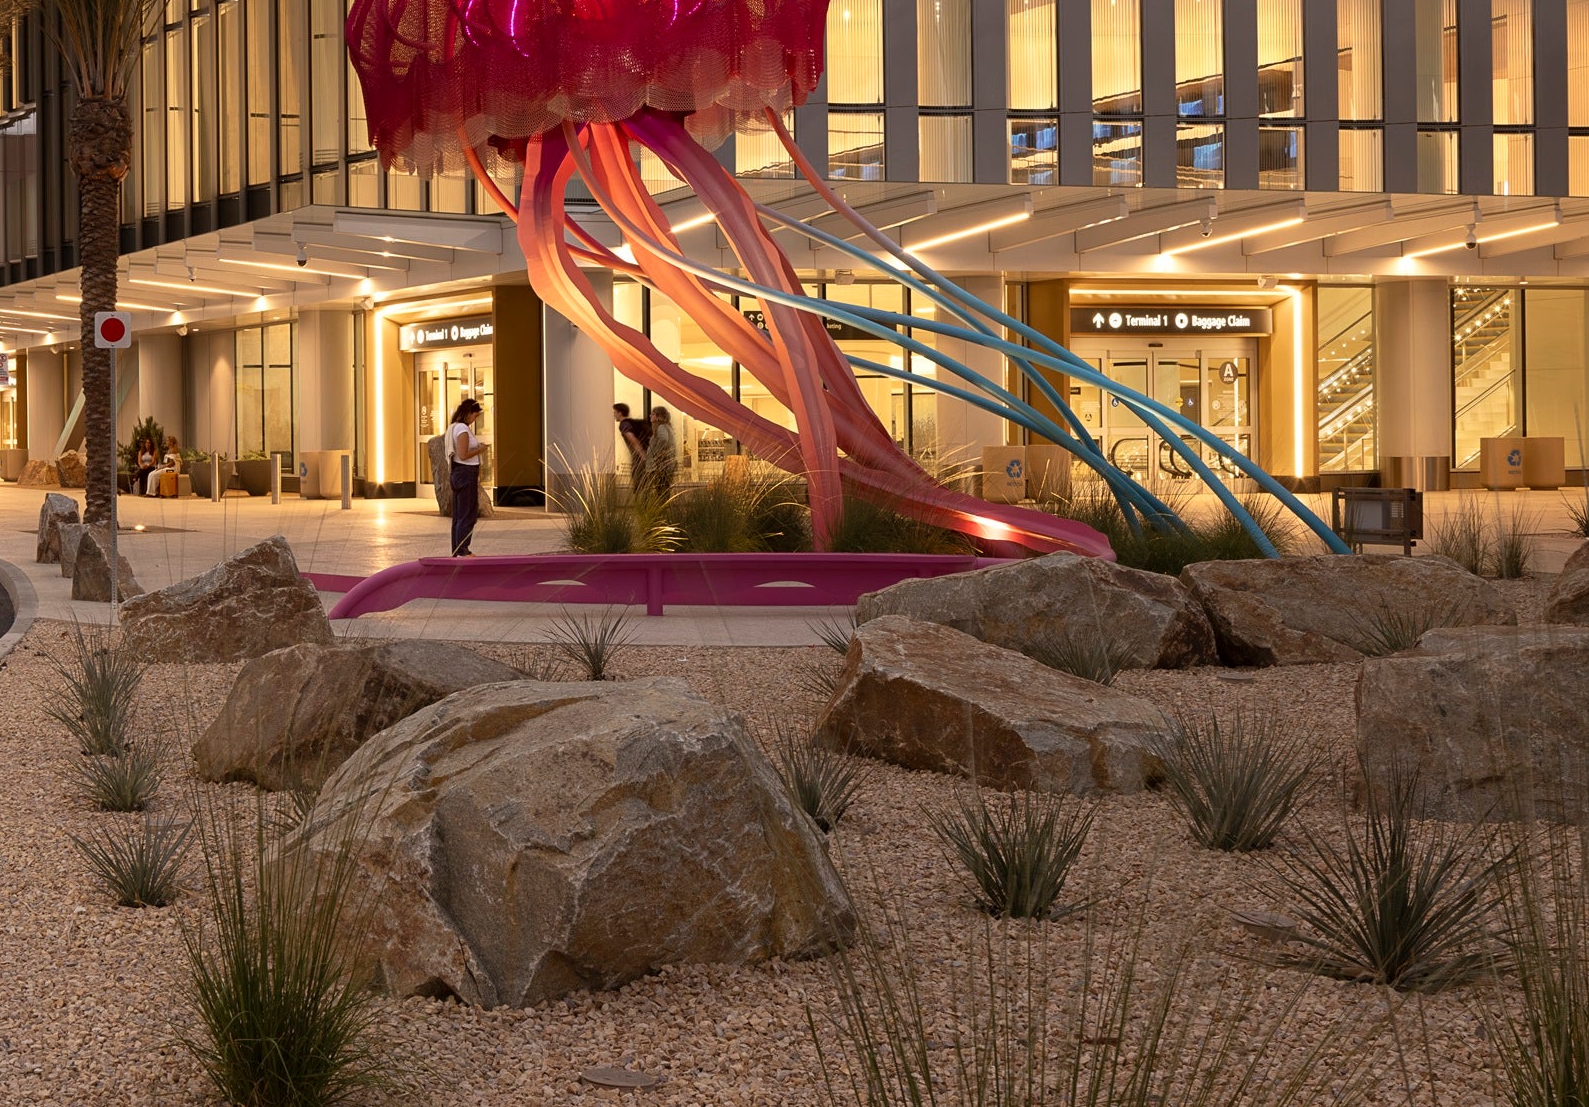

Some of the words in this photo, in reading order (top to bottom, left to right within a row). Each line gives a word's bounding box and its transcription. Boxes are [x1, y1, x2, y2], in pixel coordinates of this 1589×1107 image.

[1126, 314, 1161, 327] Terminal
[1162, 315, 1168, 327] 1
[1192, 315, 1227, 330] Baggage
[1228, 315, 1251, 327] Claim
[1223, 363, 1234, 377] A
